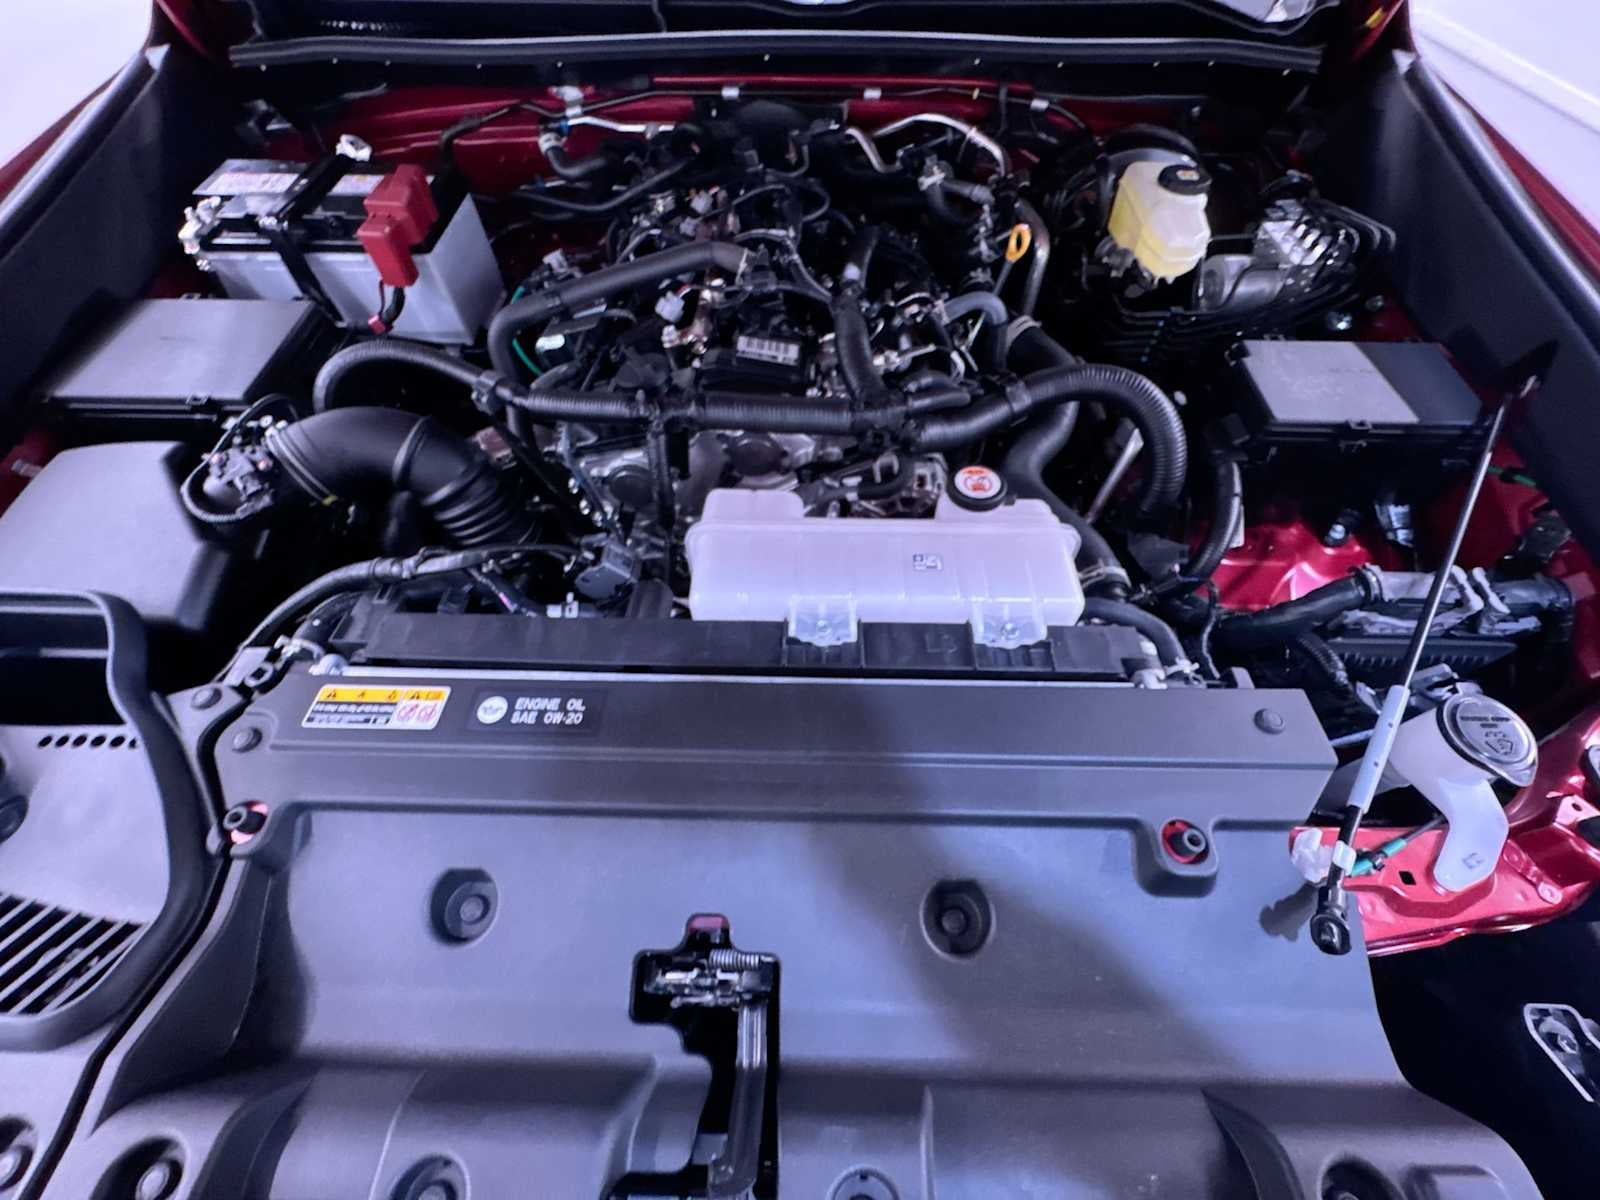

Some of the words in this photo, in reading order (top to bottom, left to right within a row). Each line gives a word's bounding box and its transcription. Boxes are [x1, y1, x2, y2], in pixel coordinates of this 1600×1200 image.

[514, 697, 562, 711] ENGINE
[566, 698, 586, 711] OIL
[510, 711, 539, 724] SAE
[543, 711, 583, 725] 0W-20
